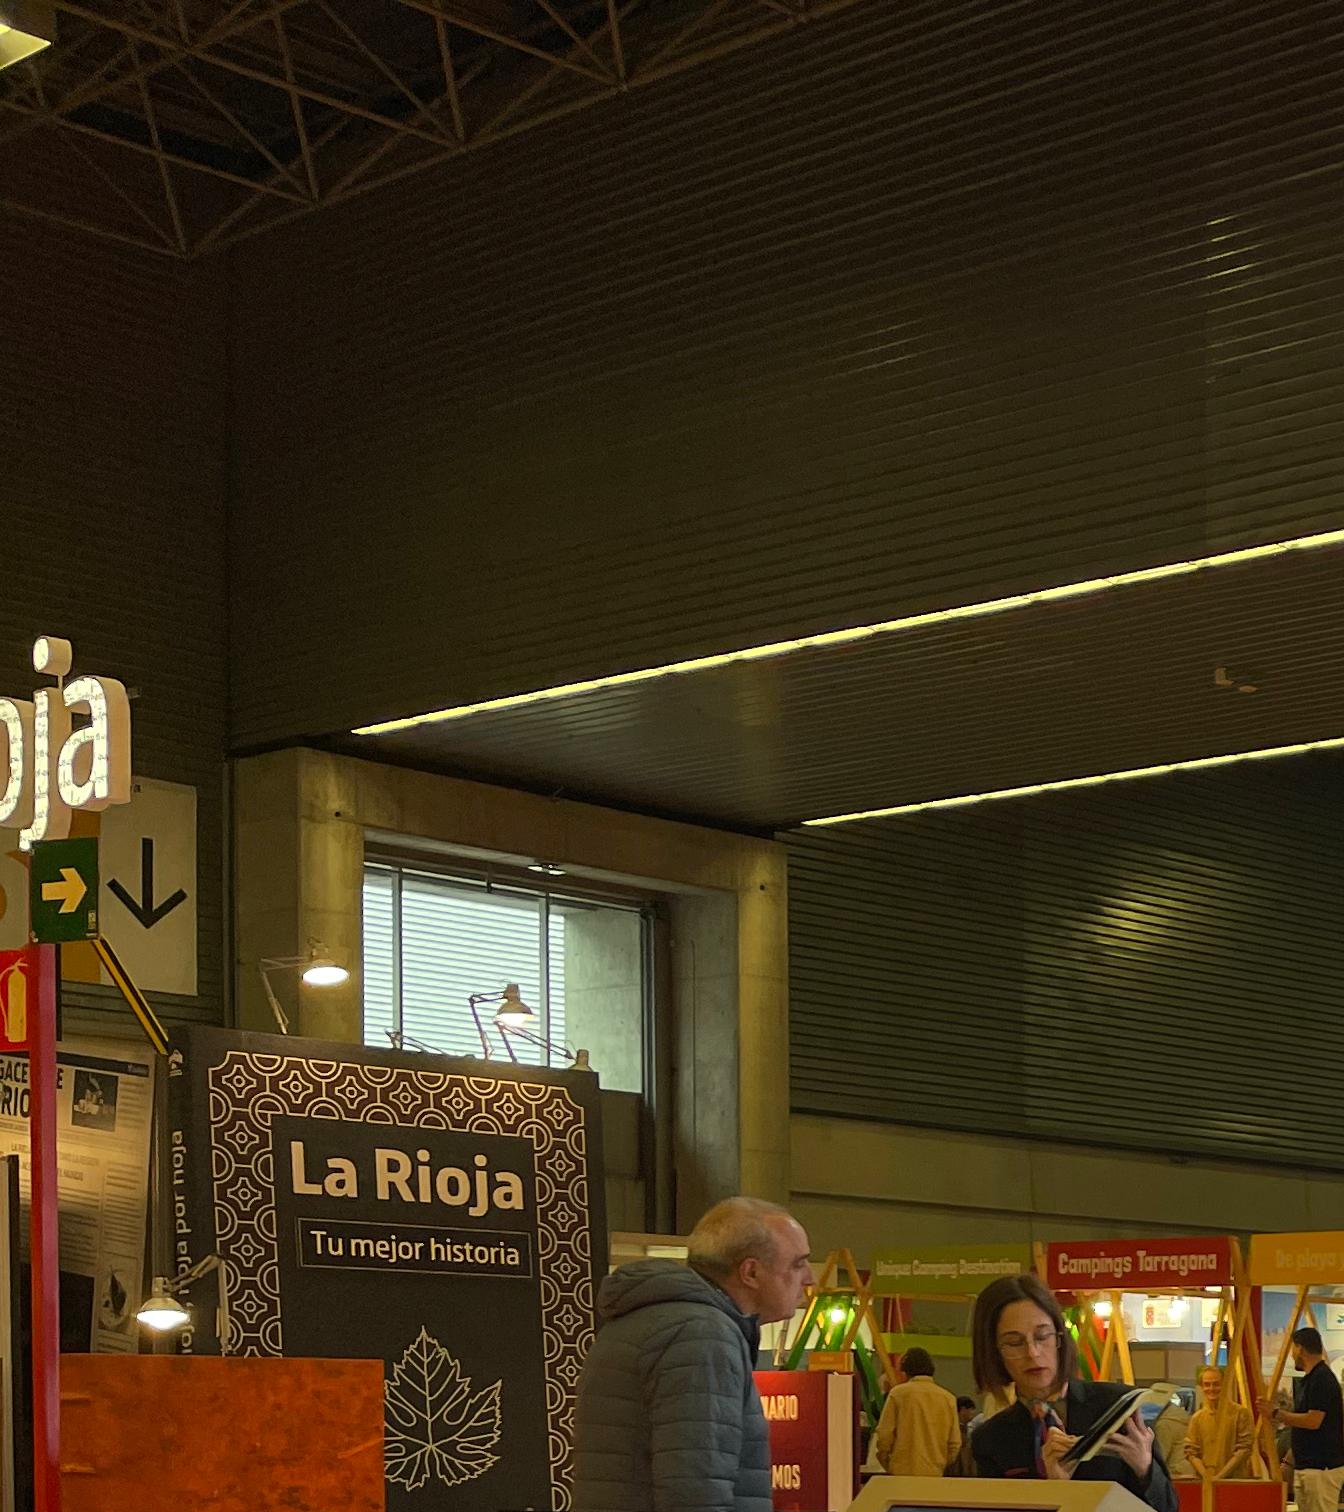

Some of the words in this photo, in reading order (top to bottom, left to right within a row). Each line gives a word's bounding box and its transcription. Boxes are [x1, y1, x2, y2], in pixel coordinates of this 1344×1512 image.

[290, 1140, 358, 1199] La
[374, 1147, 525, 1217] Rioja
[174, 1190, 192, 1234] por
[310, 1230, 344, 1257] Tu
[350, 1234, 424, 1263] mejor
[430, 1237, 520, 1266] historia
[1058, 1251, 1132, 1279] Campings
